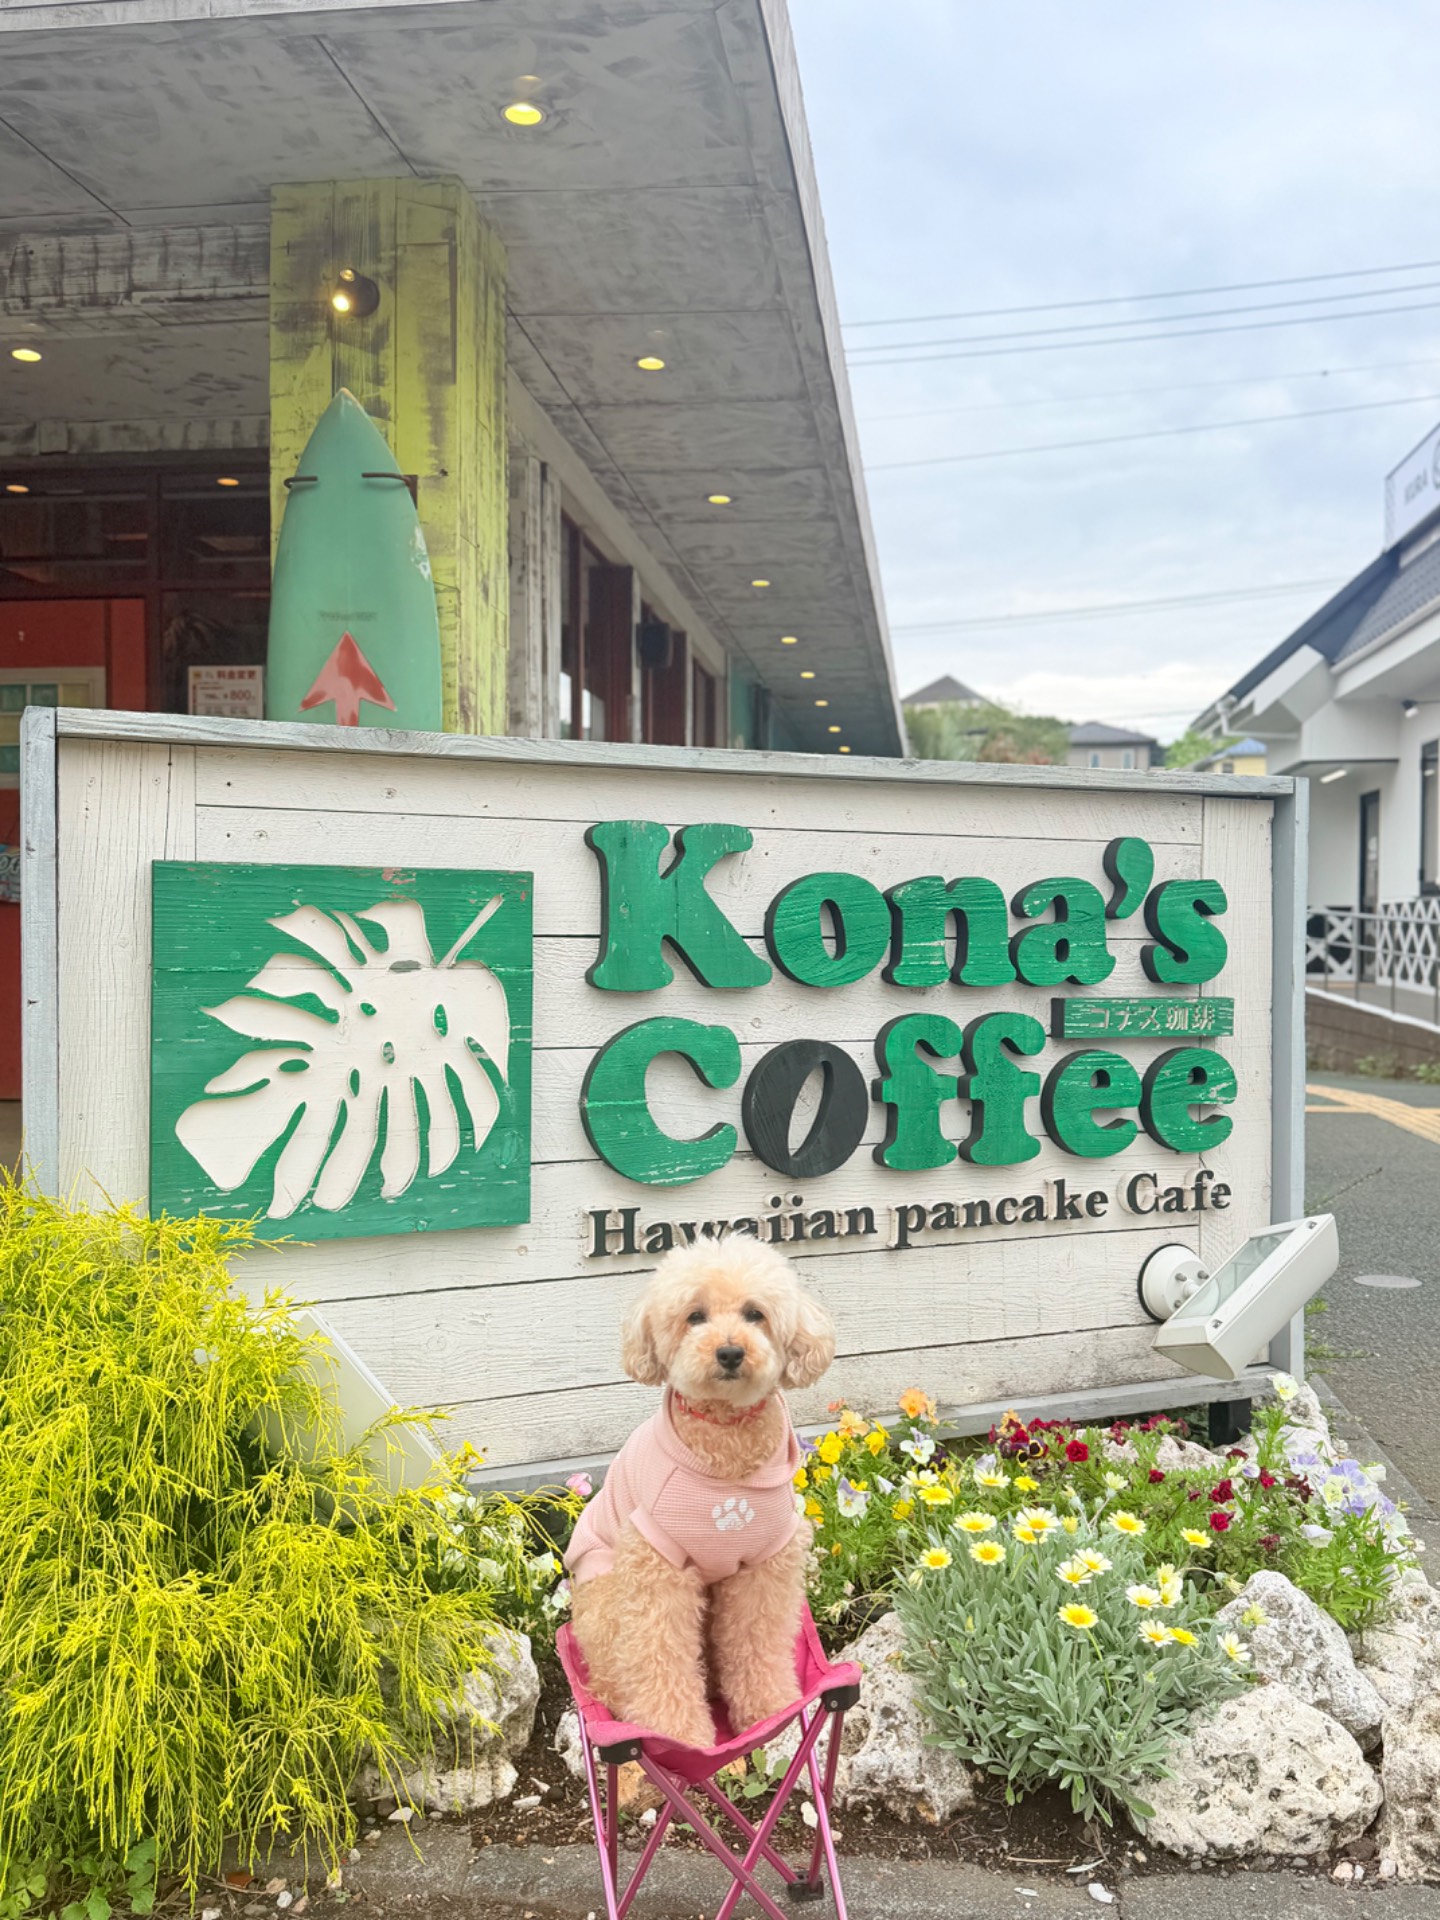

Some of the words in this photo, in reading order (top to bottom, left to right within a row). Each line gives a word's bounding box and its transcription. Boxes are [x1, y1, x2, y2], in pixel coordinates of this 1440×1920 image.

[584, 819, 1228, 992] Kona's
[1090, 1004, 1216, 1031] コナス珈琲
[581, 1012, 1238, 1186] Coffee
[893, 1179, 1108, 1248] pancake
[1124, 1168, 1233, 1215] Cafe
